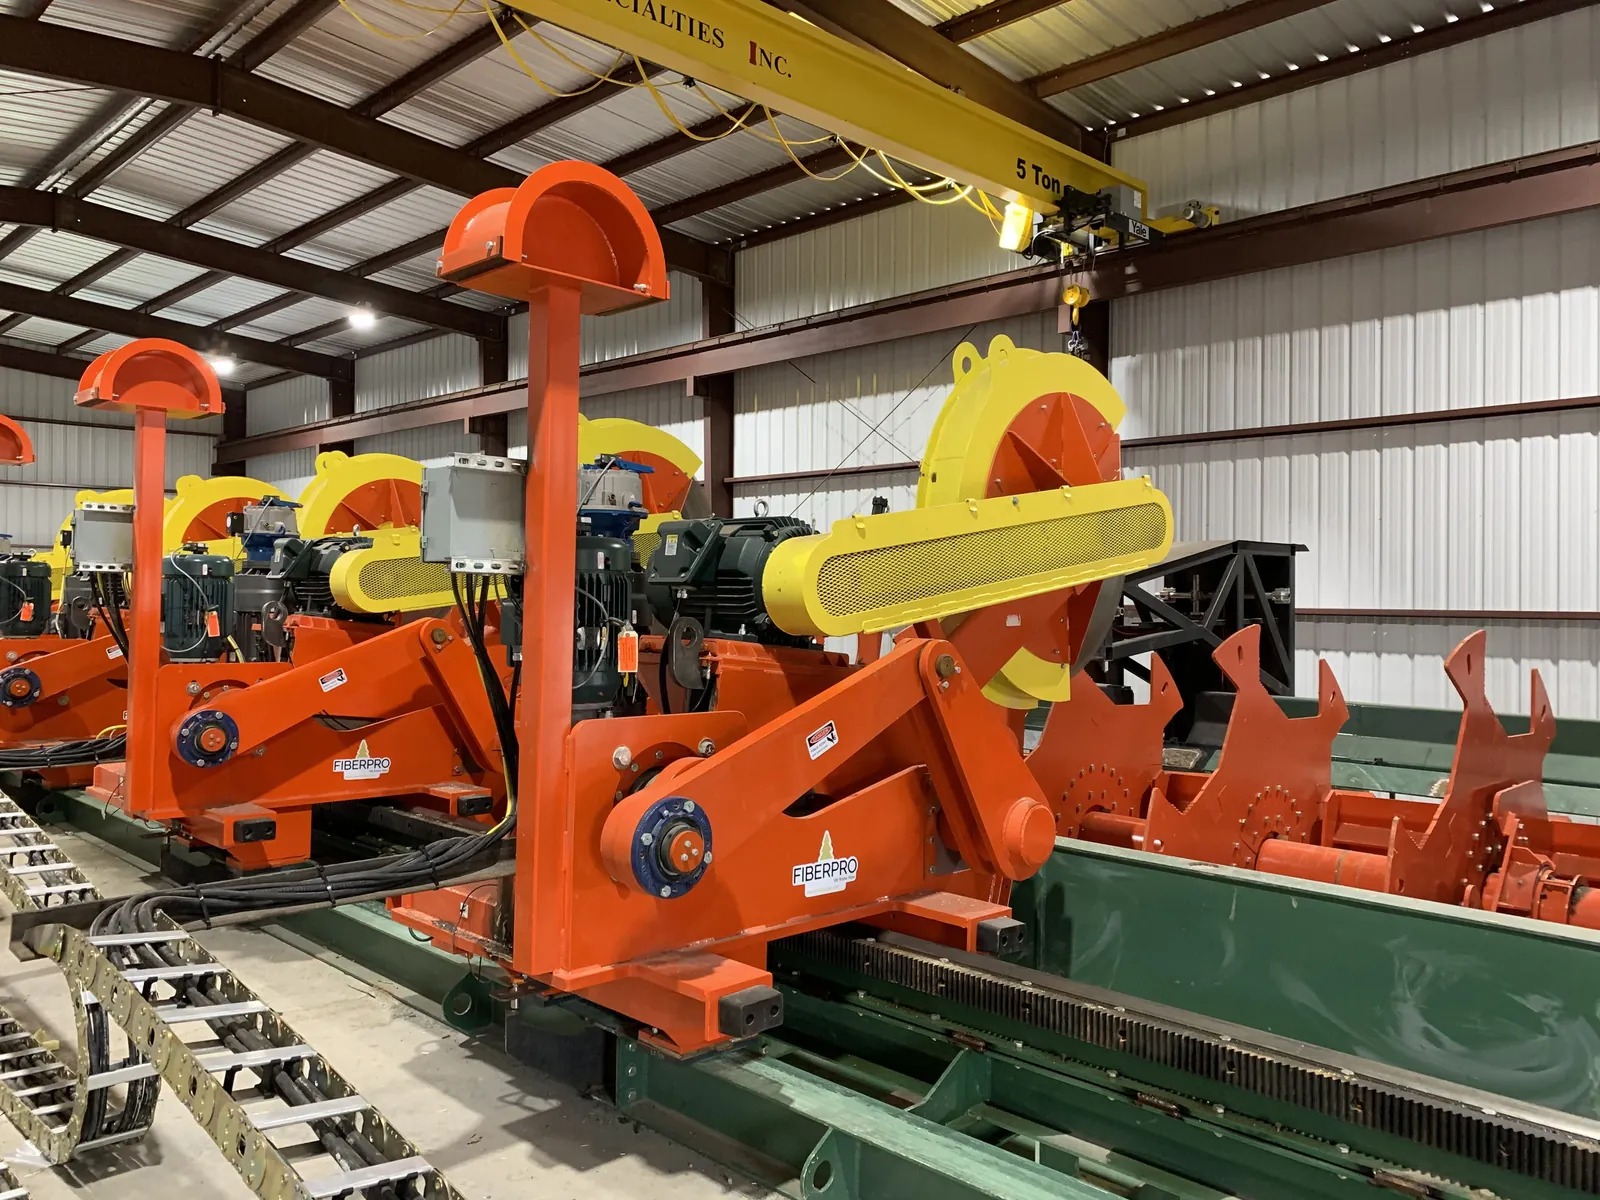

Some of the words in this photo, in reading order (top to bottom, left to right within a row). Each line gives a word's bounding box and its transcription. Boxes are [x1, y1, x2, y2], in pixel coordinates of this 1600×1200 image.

[749, 41, 792, 78] INC.
[1016, 157, 1026, 180] 5
[1032, 163, 1061, 194] Ton
[1131, 220, 1147, 238] Yale
[333, 758, 390, 771] FIBERPRO
[793, 858, 857, 884] FIBERPRO
